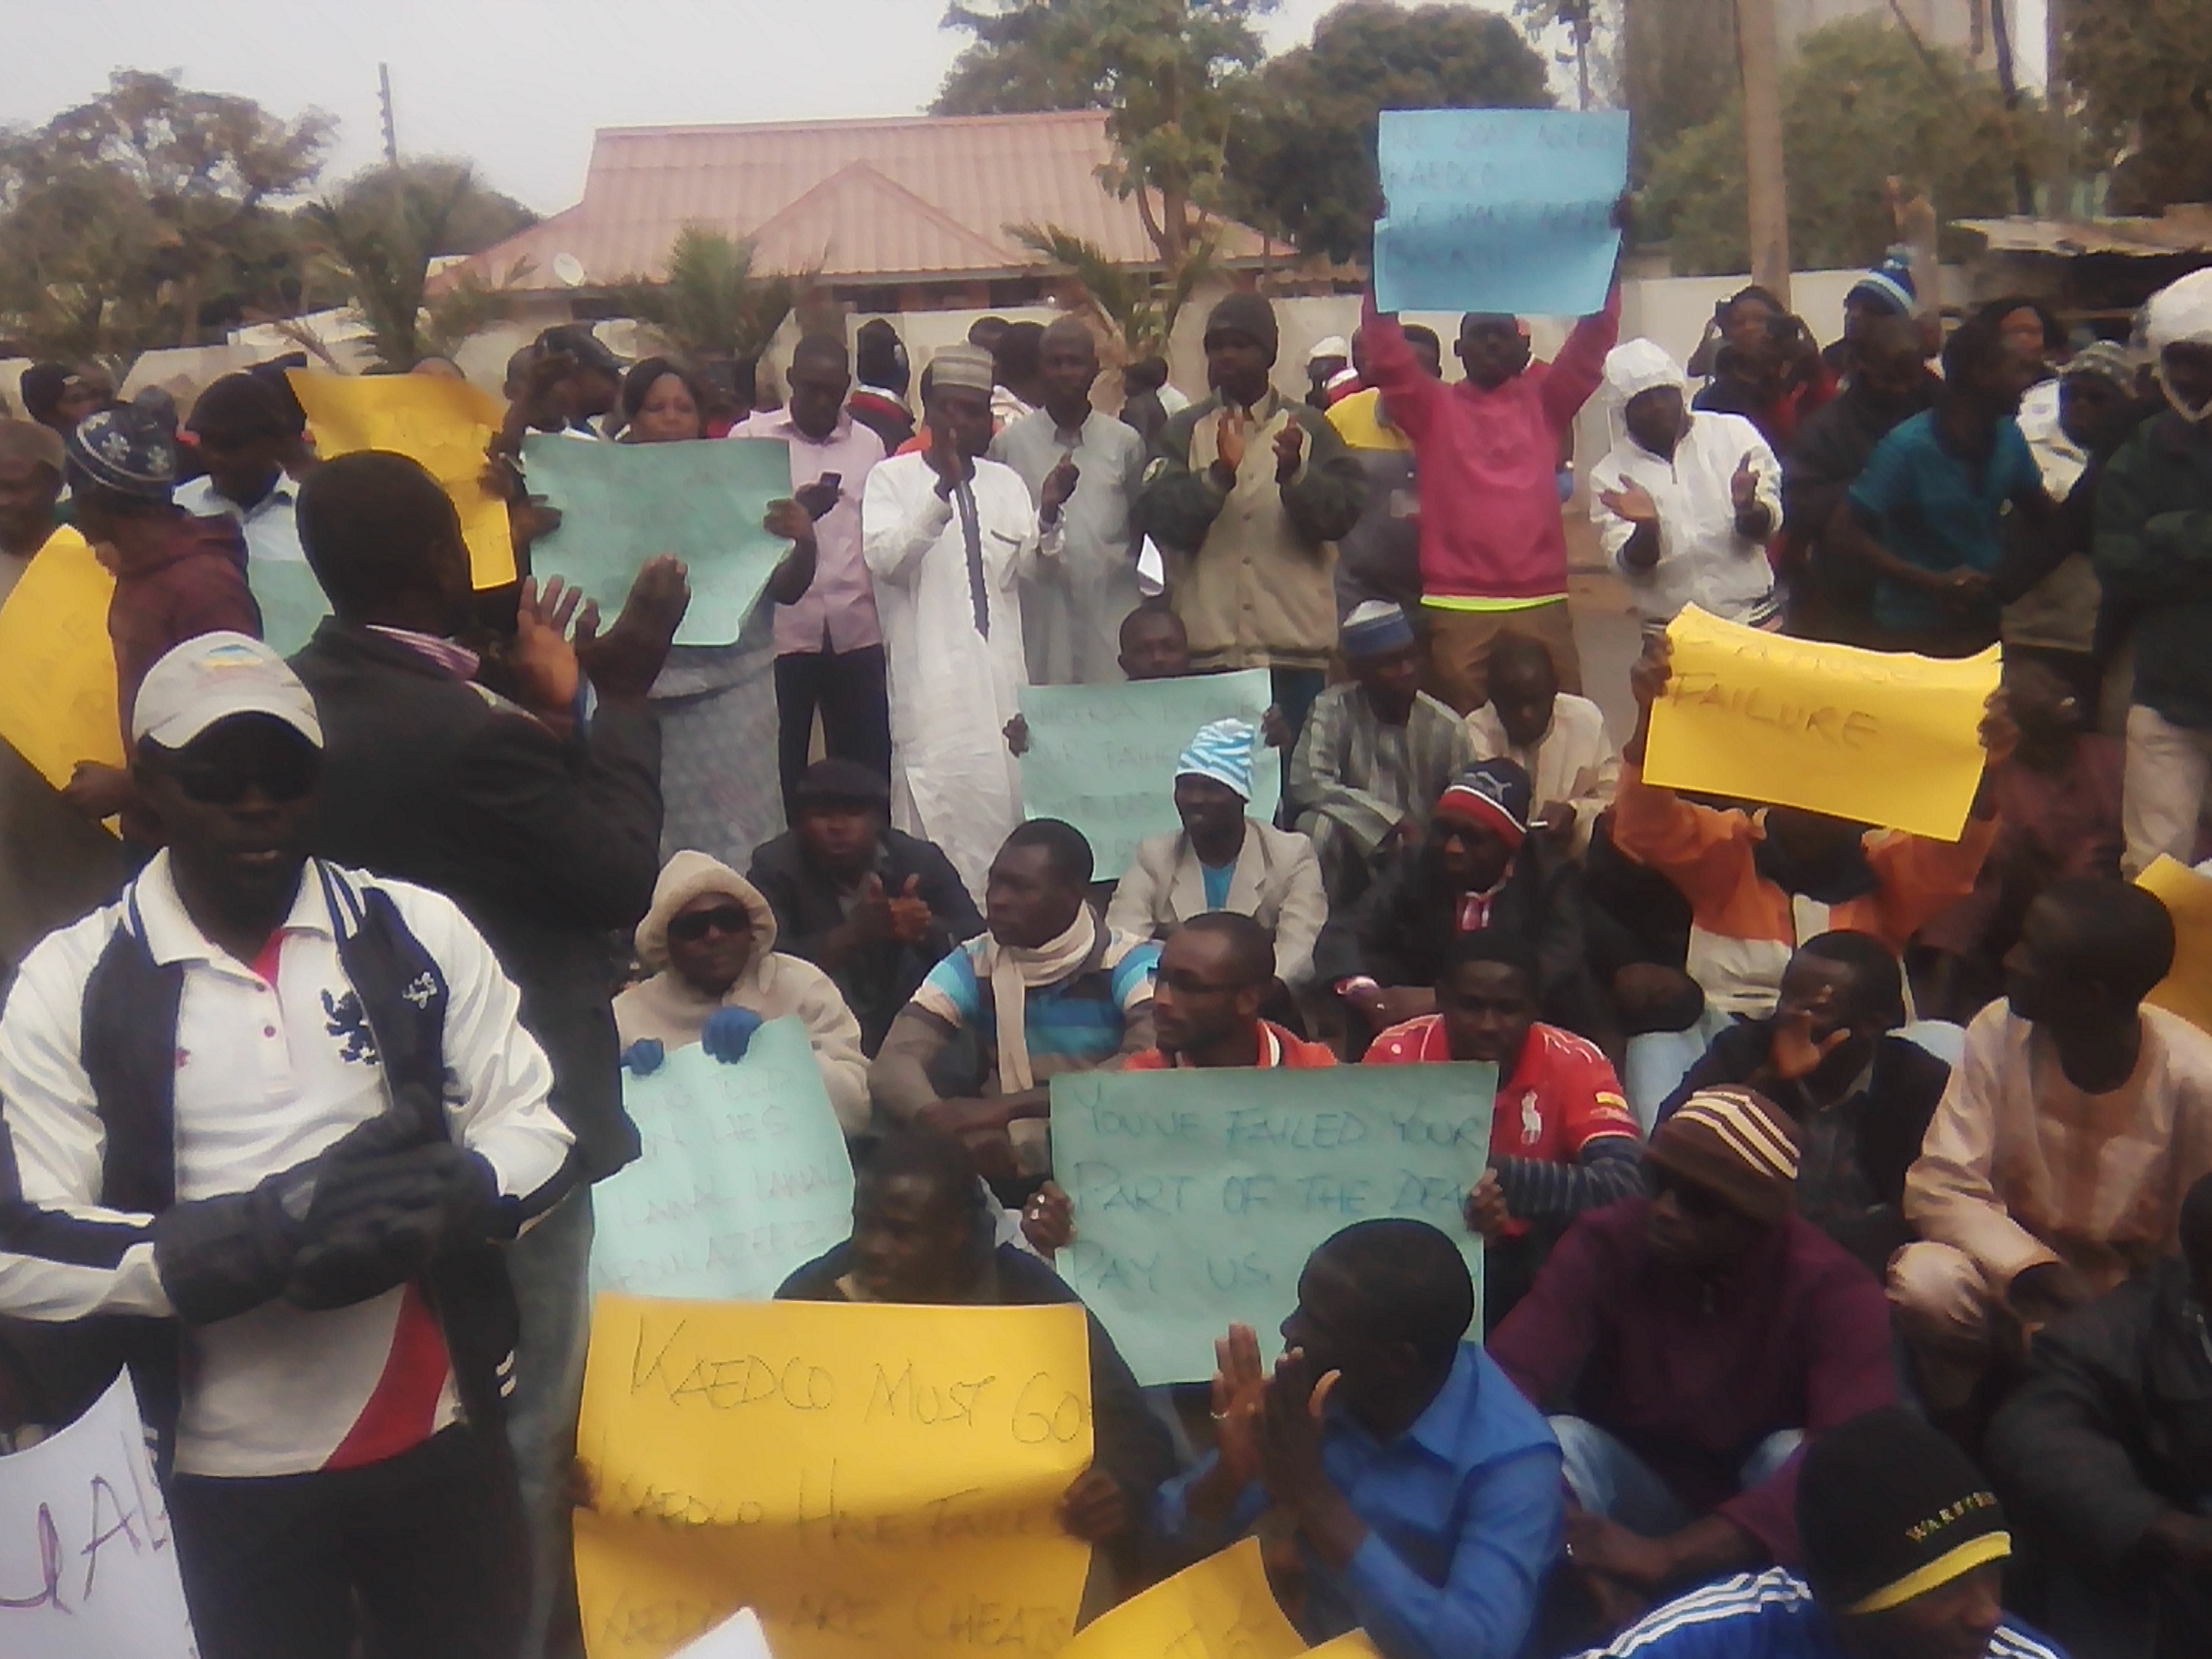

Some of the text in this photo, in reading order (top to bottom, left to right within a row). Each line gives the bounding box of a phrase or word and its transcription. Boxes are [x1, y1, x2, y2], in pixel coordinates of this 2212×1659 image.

[1671, 671, 1879, 752] FAILURE
[1224, 1106, 1368, 1150] FAILED
[1389, 1101, 1484, 1151] YOUR
[1072, 1160, 1469, 1216] PART OF THE DEA
[1072, 1238, 1271, 1294] PAY US
[631, 1313, 1083, 1444] KAEDCO MUST GO
